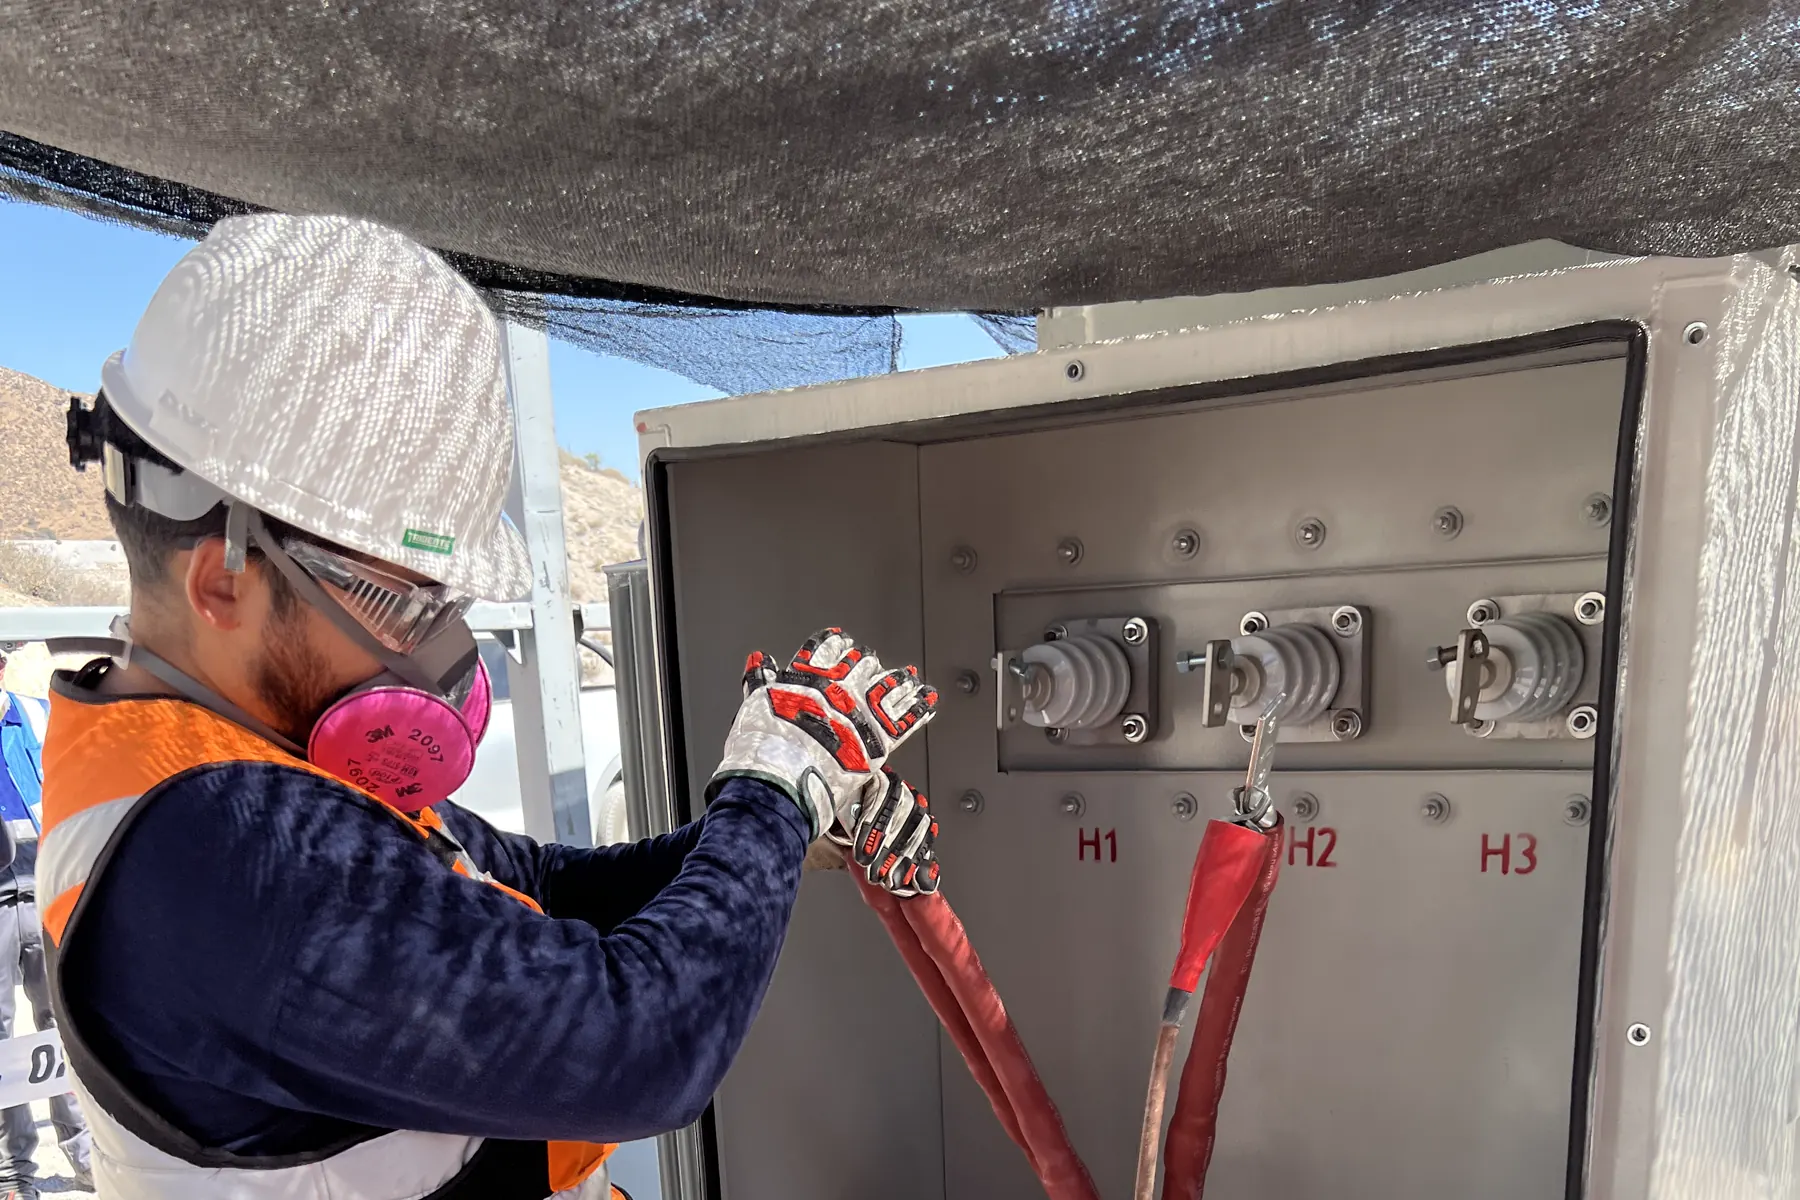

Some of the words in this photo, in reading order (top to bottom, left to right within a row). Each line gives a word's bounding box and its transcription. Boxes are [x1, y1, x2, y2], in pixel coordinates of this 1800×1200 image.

[365, 725, 395, 744] 3M
[408, 728, 444, 763] 2097
[347, 757, 380, 794] 2097
[395, 781, 423, 798] 3M
[1079, 827, 1117, 863] H1
[1288, 826, 1338, 868] H2
[1481, 833, 1538, 875] H3
